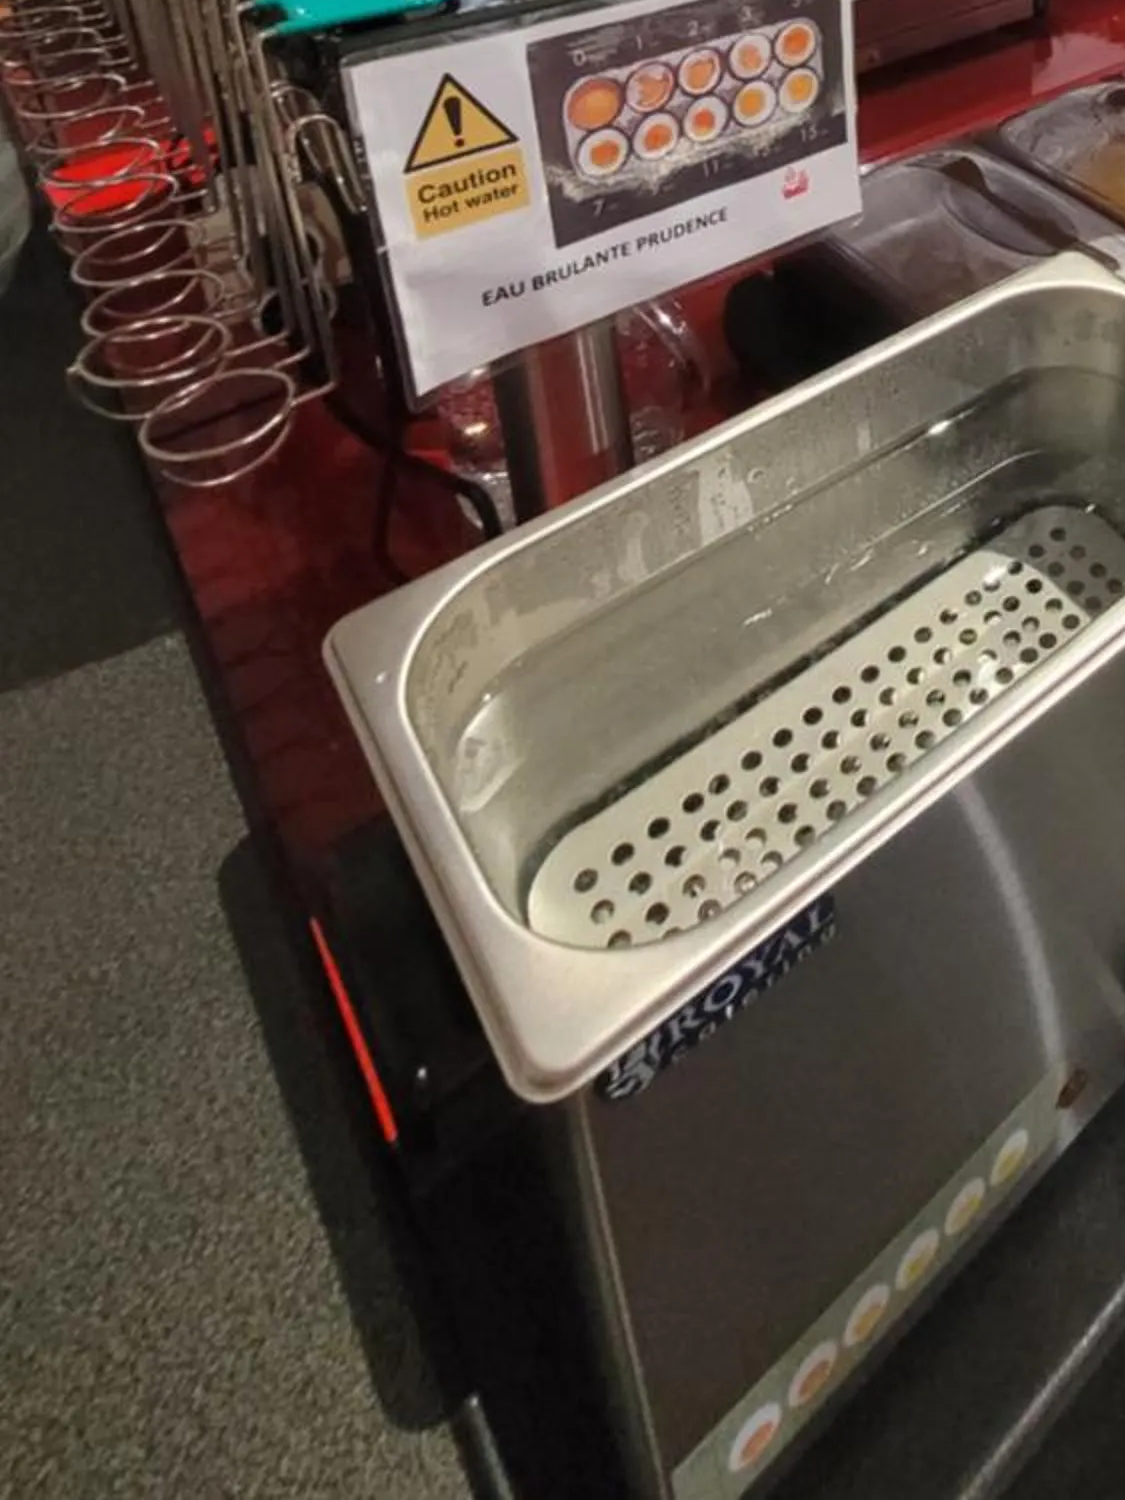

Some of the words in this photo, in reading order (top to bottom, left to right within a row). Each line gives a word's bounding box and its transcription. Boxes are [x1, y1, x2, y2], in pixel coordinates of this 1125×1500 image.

[416, 162, 518, 206] Caution
[422, 199, 461, 224] Hot
[464, 181, 519, 209] water
[481, 281, 526, 308] EAU
[530, 241, 633, 292] BRULANTE
[635, 205, 730, 252] PRUDENCE
[664, 904, 836, 1048] ROYAL
